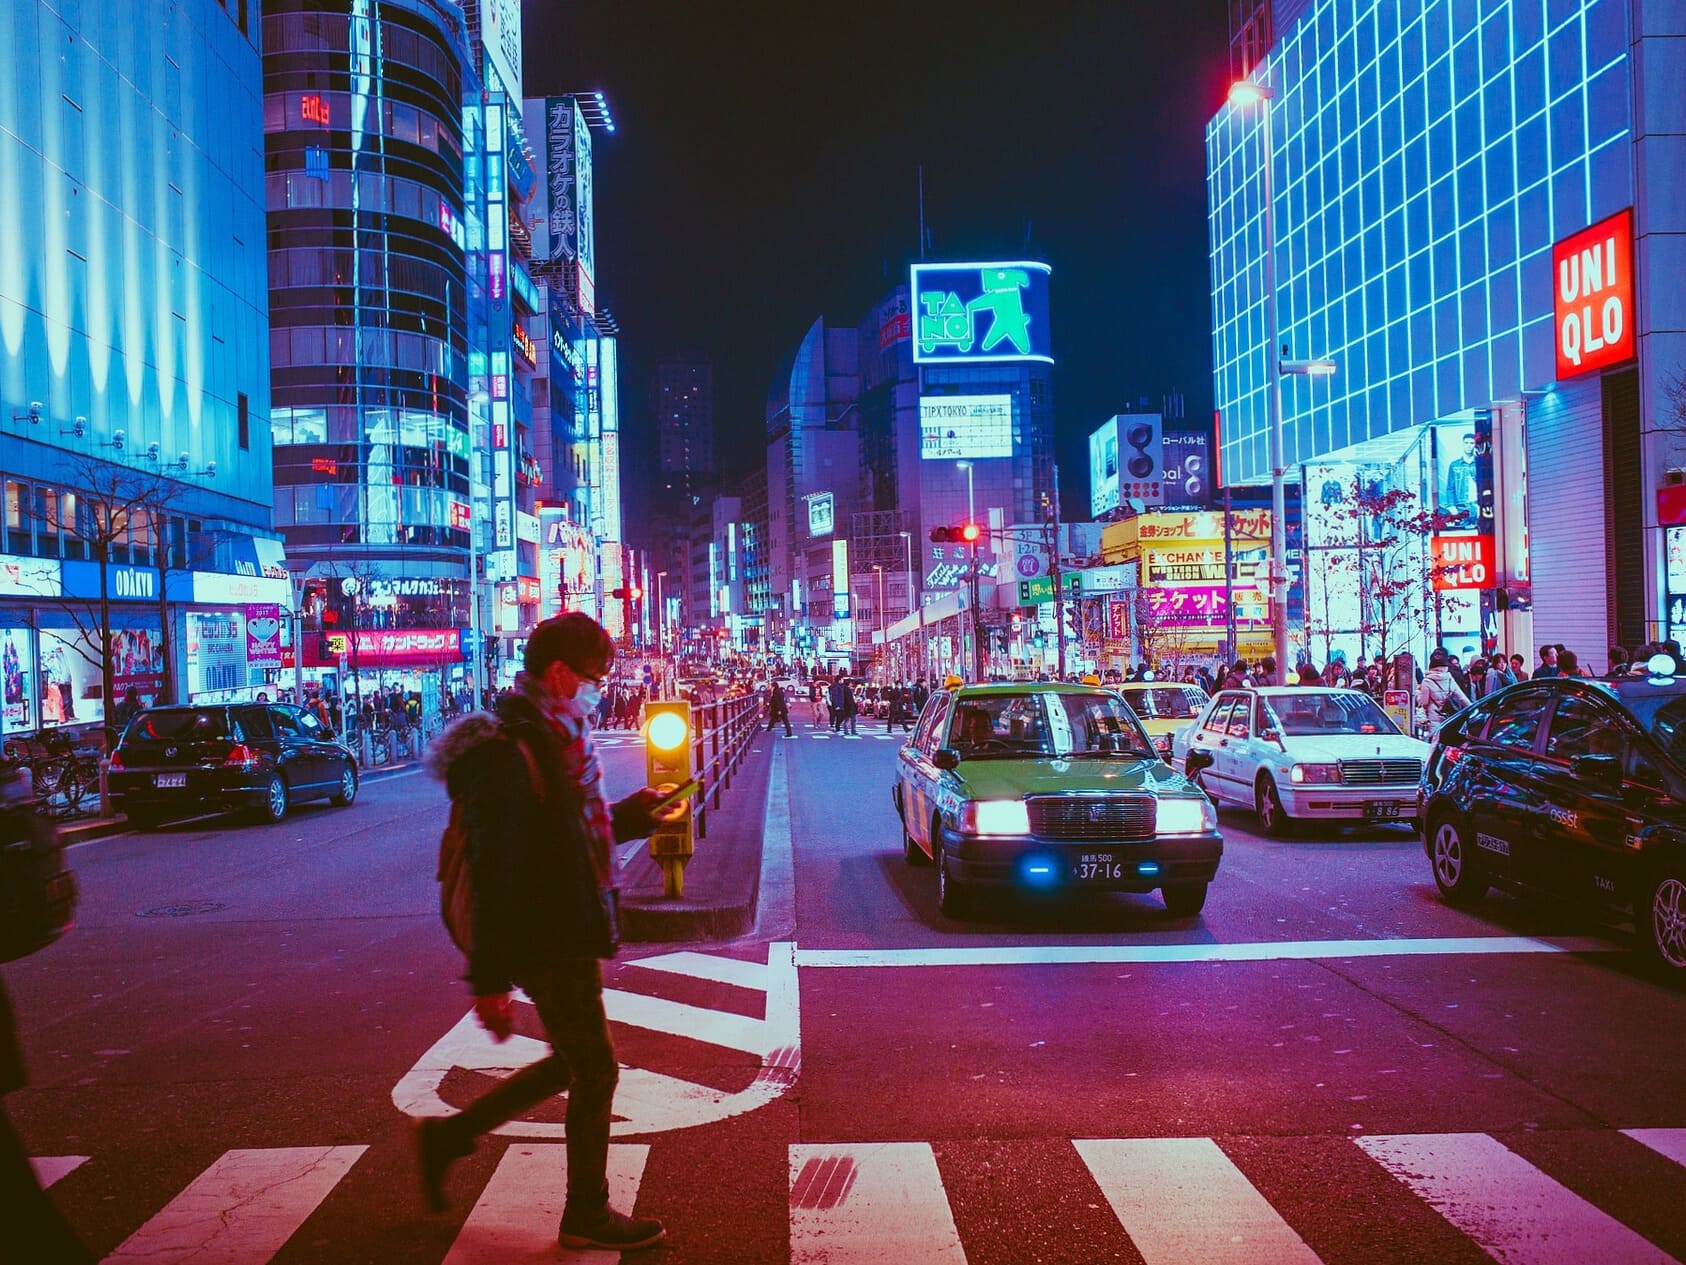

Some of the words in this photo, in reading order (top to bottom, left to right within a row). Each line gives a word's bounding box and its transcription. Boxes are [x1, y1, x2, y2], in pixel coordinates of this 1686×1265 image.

[550, 102, 577, 259] カラオケの鉄人
[1560, 237, 1616, 303] UNI
[921, 291, 967, 315] TA
[921, 315, 969, 340] NO
[1561, 296, 1623, 366] QLO
[1443, 541, 1481, 561] UNI
[1444, 563, 1486, 587] QLO
[1149, 590, 1226, 610] チケット
[1112, 603, 1121, 636] チケット
[382, 634, 445, 651] サンドラッグ
[1097, 854, 1112, 862] 500
[1080, 863, 1121, 879] 37-16
[1592, 874, 1615, 893] TAXI
